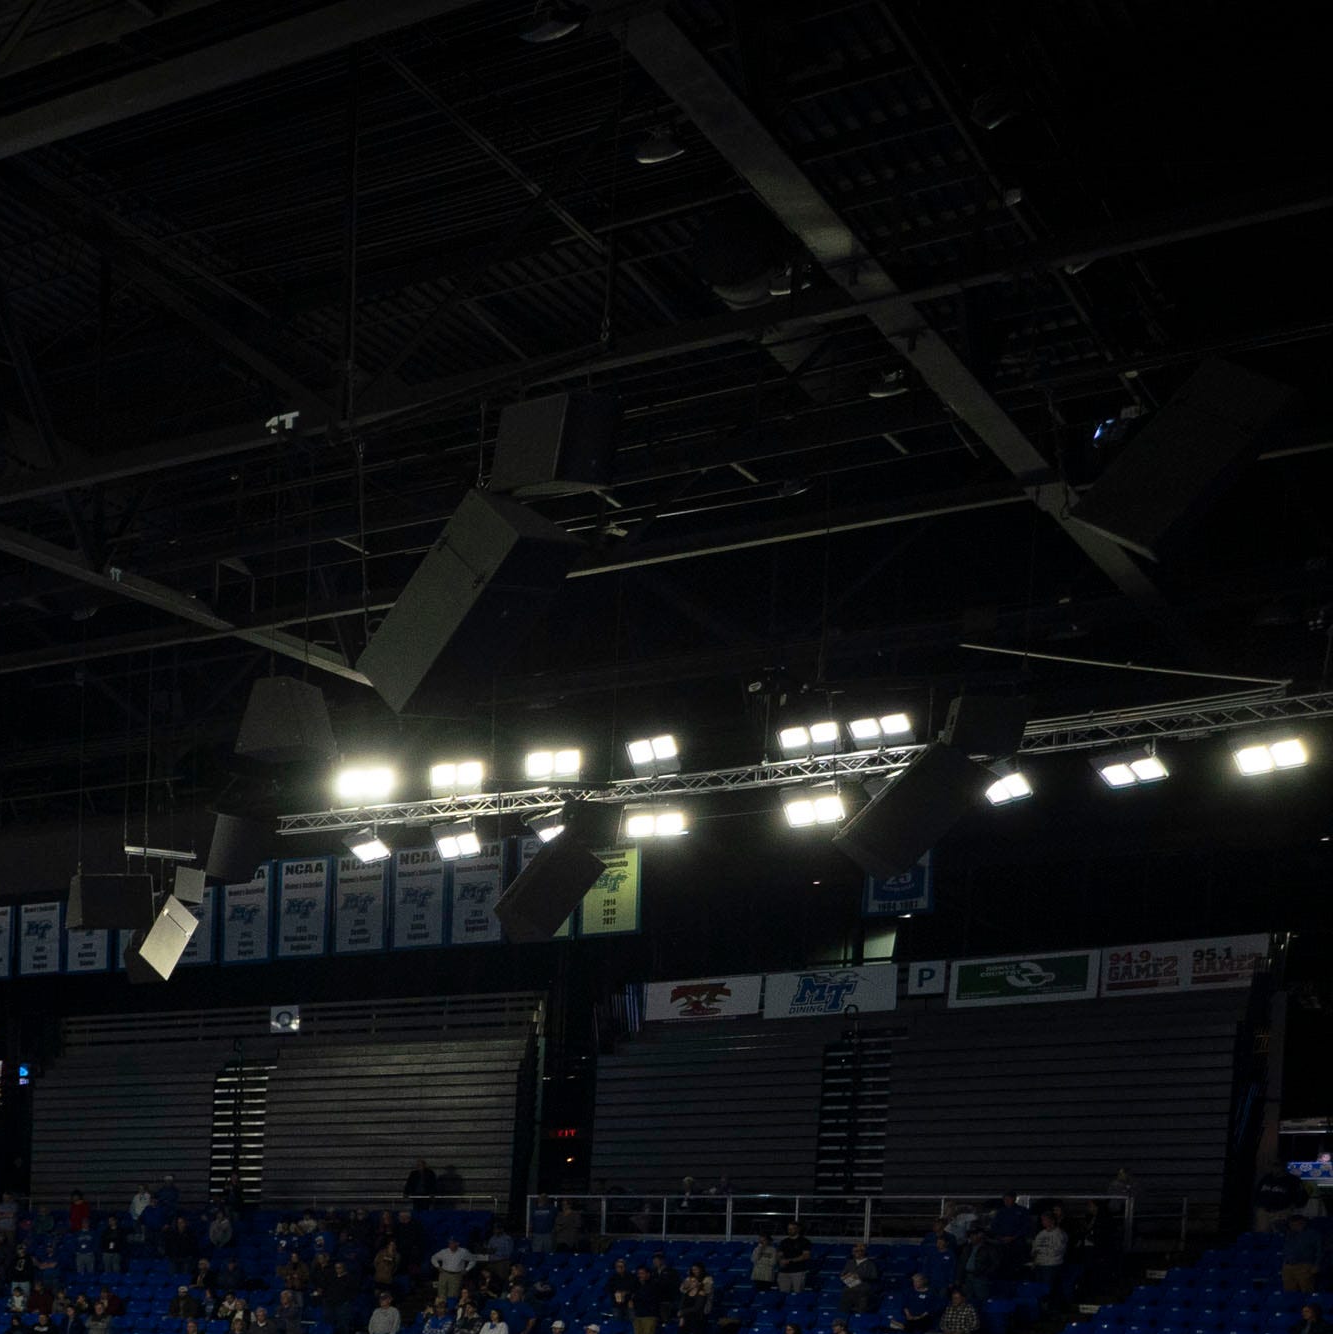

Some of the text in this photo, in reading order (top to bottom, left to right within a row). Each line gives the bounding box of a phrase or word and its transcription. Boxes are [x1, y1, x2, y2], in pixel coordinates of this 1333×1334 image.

[285, 862, 324, 876] NCAA
[1109, 950, 1151, 965] 94.9
[1192, 947, 1233, 960] 95.1
[918, 968, 934, 987] P
[789, 1005, 824, 1013] DINING
